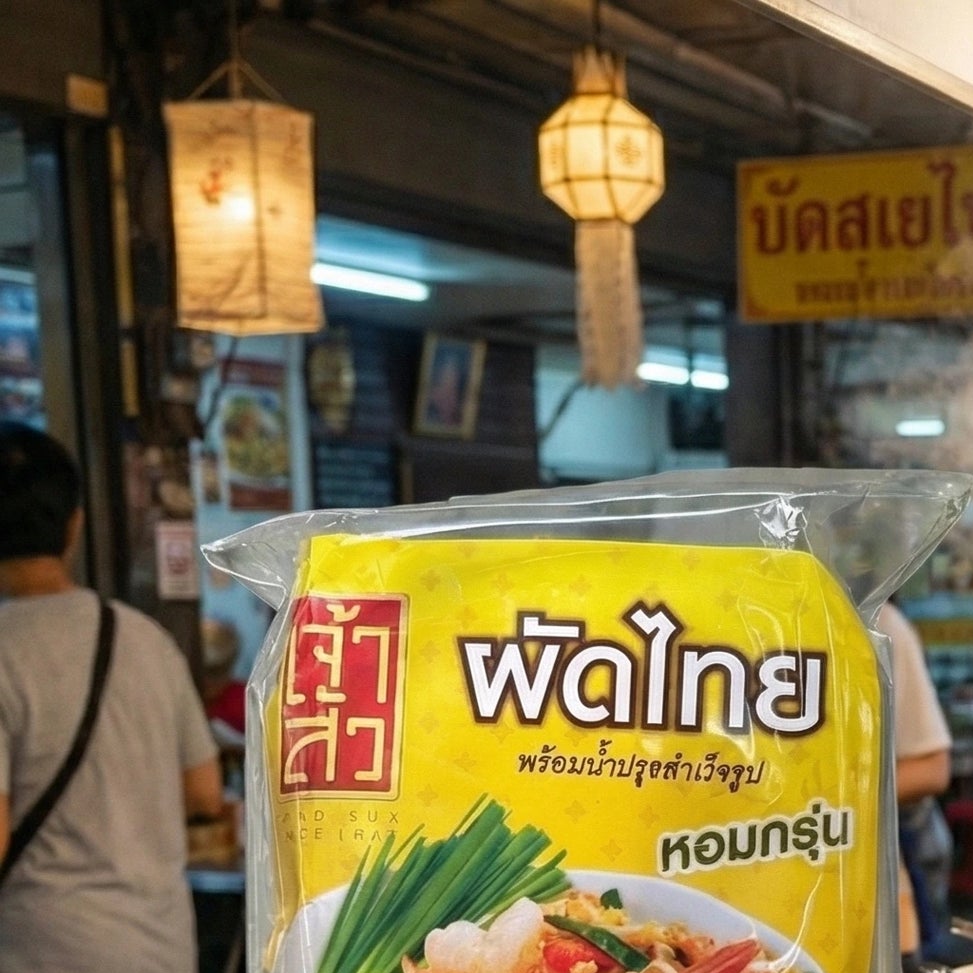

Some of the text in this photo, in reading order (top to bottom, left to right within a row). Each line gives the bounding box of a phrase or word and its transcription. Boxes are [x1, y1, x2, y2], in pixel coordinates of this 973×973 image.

[459, 602, 825, 734] ผัดไทย
[661, 802, 849, 872] หอมกรุ่น
